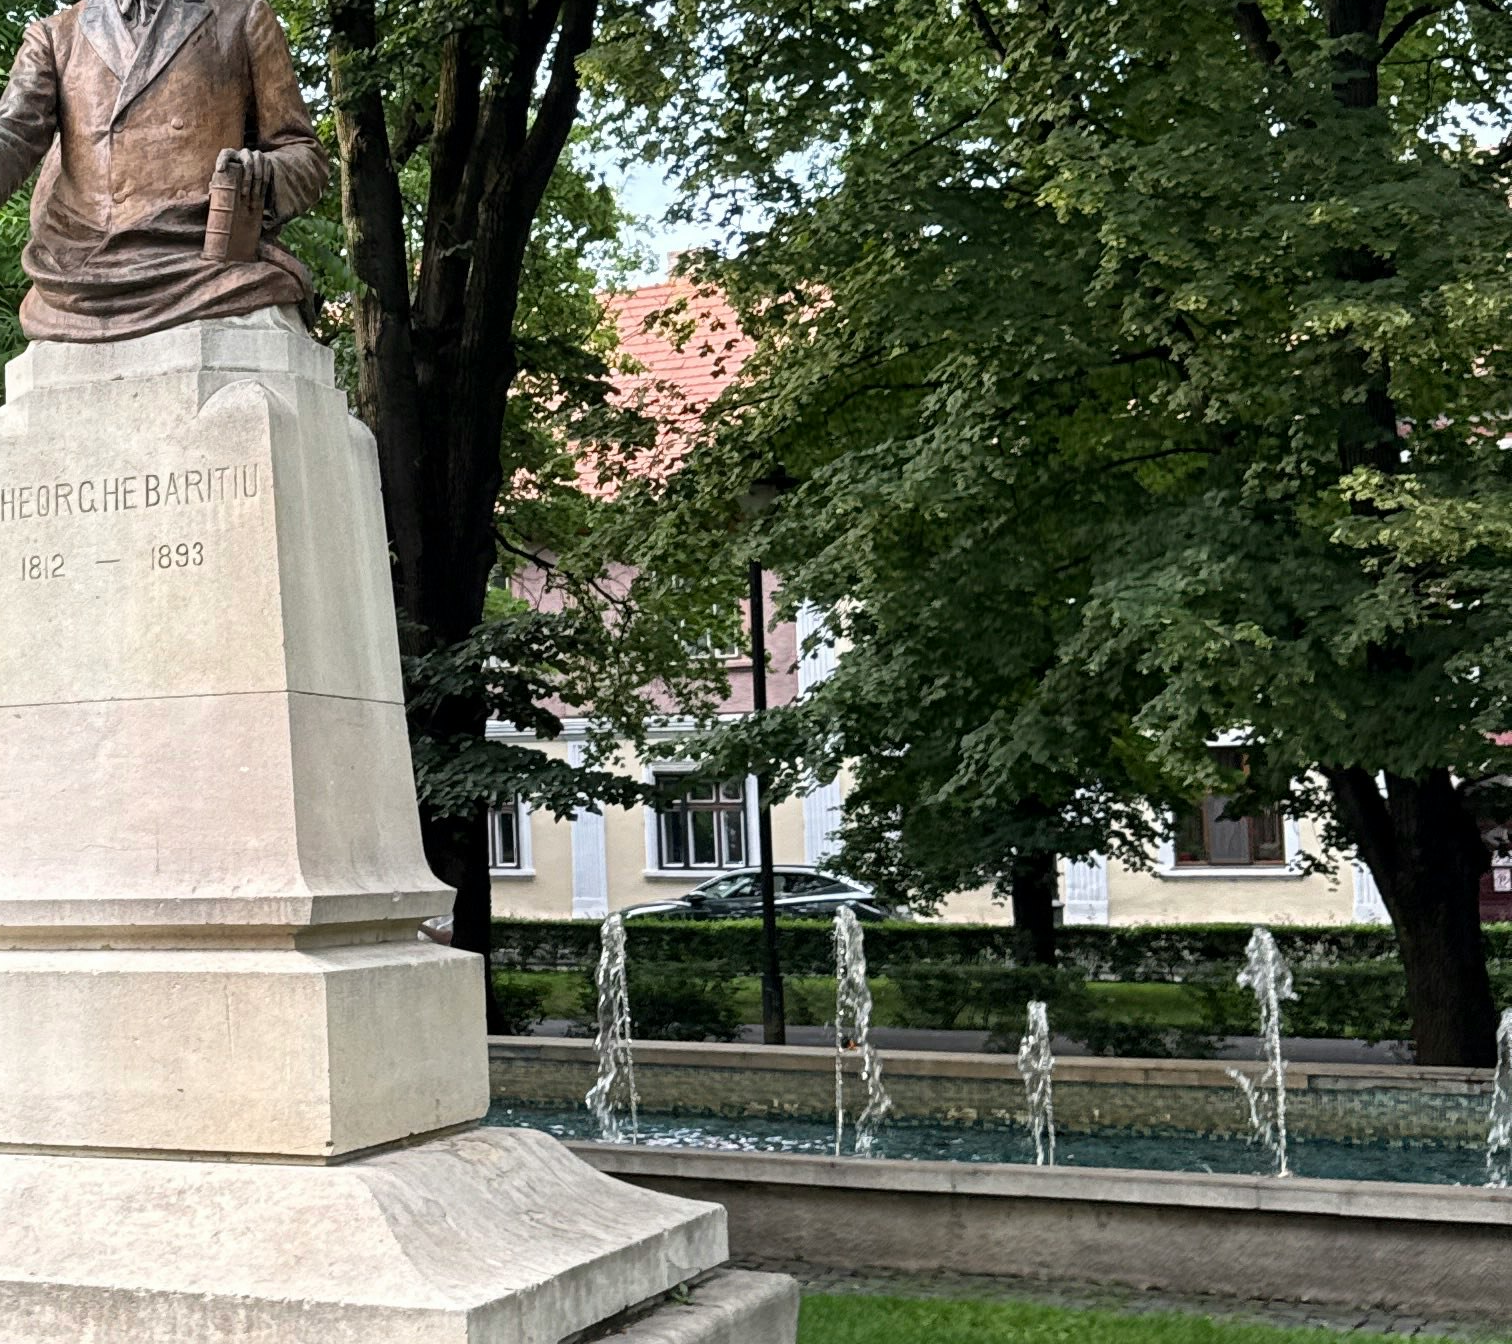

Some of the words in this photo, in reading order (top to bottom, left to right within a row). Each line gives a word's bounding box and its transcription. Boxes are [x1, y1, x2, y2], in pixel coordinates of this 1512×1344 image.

[145, 464, 259, 508] BARITIU
[21, 553, 66, 582] 1812
[151, 541, 204, 570] 1893
